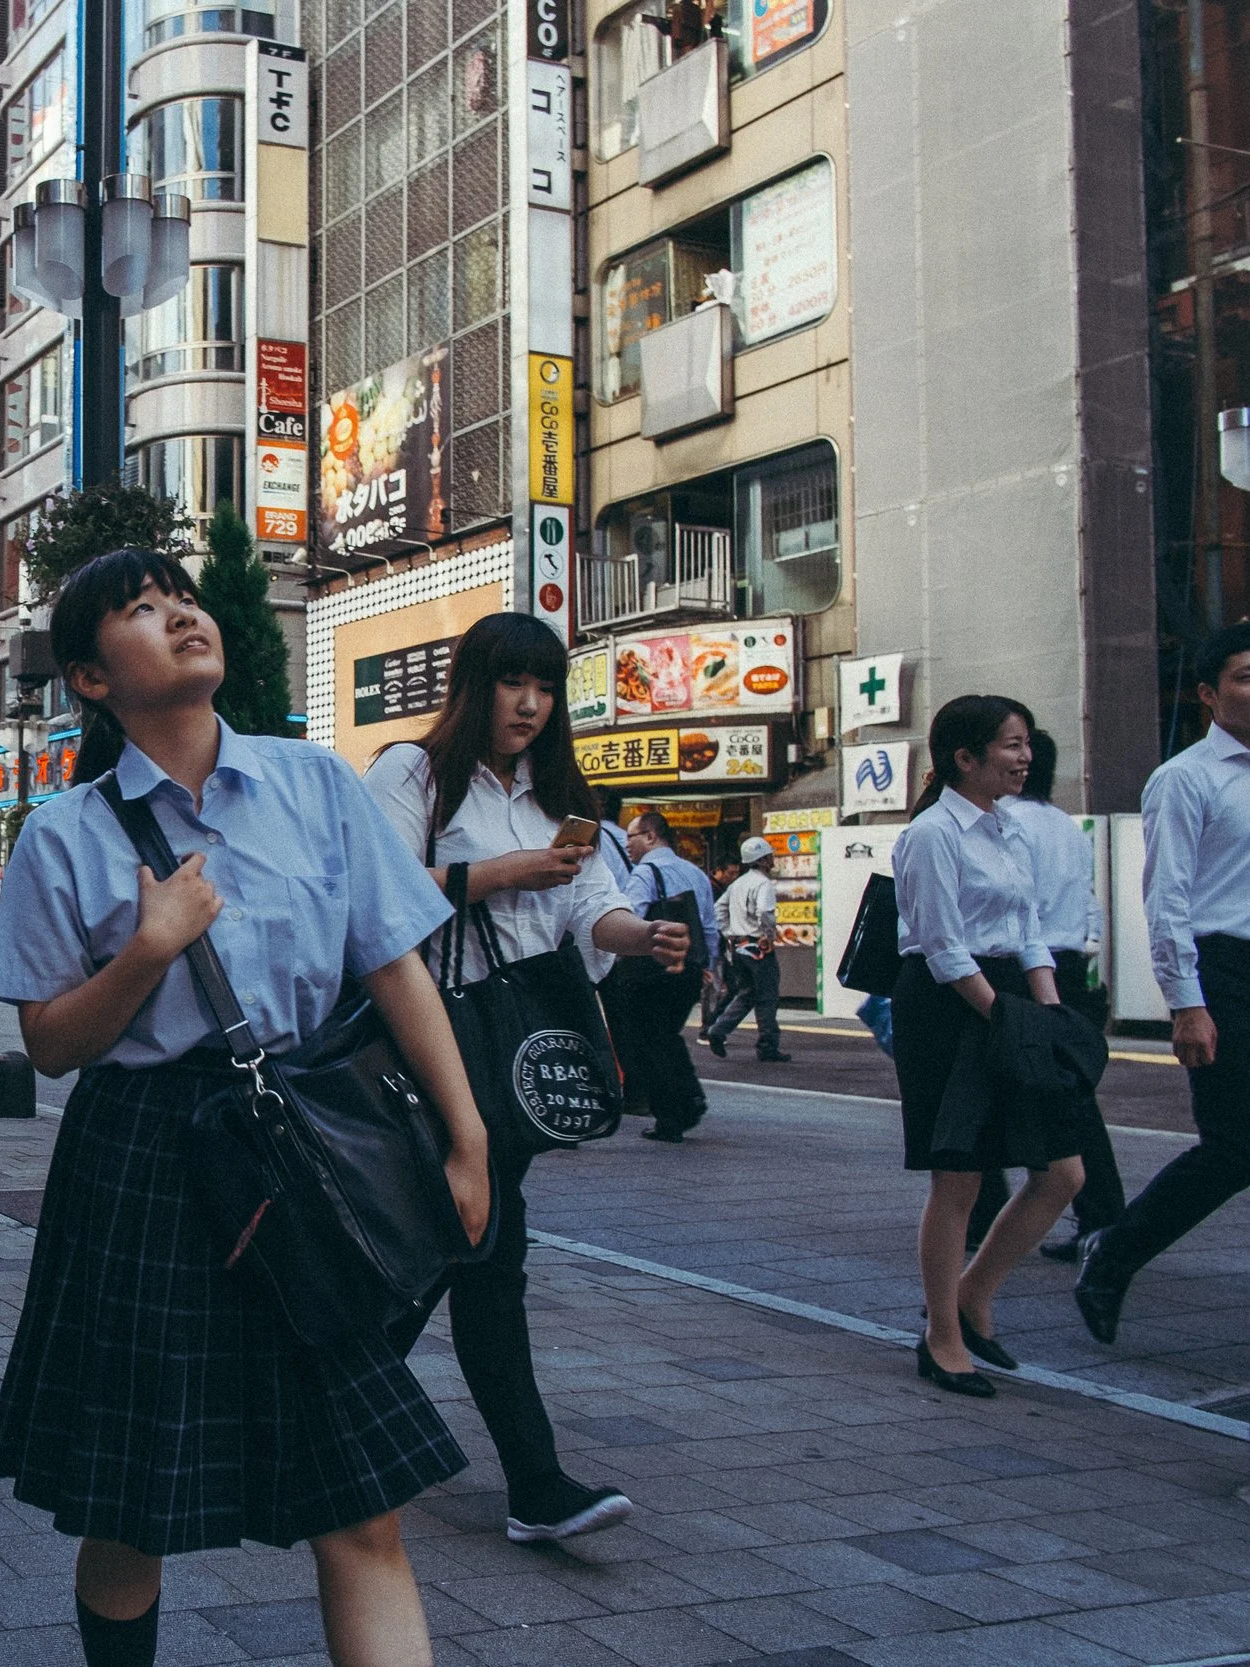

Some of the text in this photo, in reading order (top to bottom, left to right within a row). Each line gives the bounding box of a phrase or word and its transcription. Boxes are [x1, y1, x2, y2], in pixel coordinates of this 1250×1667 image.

[268, 48, 292, 58] 7F
[268, 69, 293, 132] TFC
[259, 414, 303, 436] Cafe
[263, 481, 300, 492] EXCHANGE
[335, 467, 407, 524] 水タバコ
[265, 511, 297, 521] BRAND
[265, 520, 297, 536] 729
[355, 683, 381, 699] ROLEX
[576, 737, 671, 772] oCo壱番屋
[546, 1093, 565, 1105] 20
